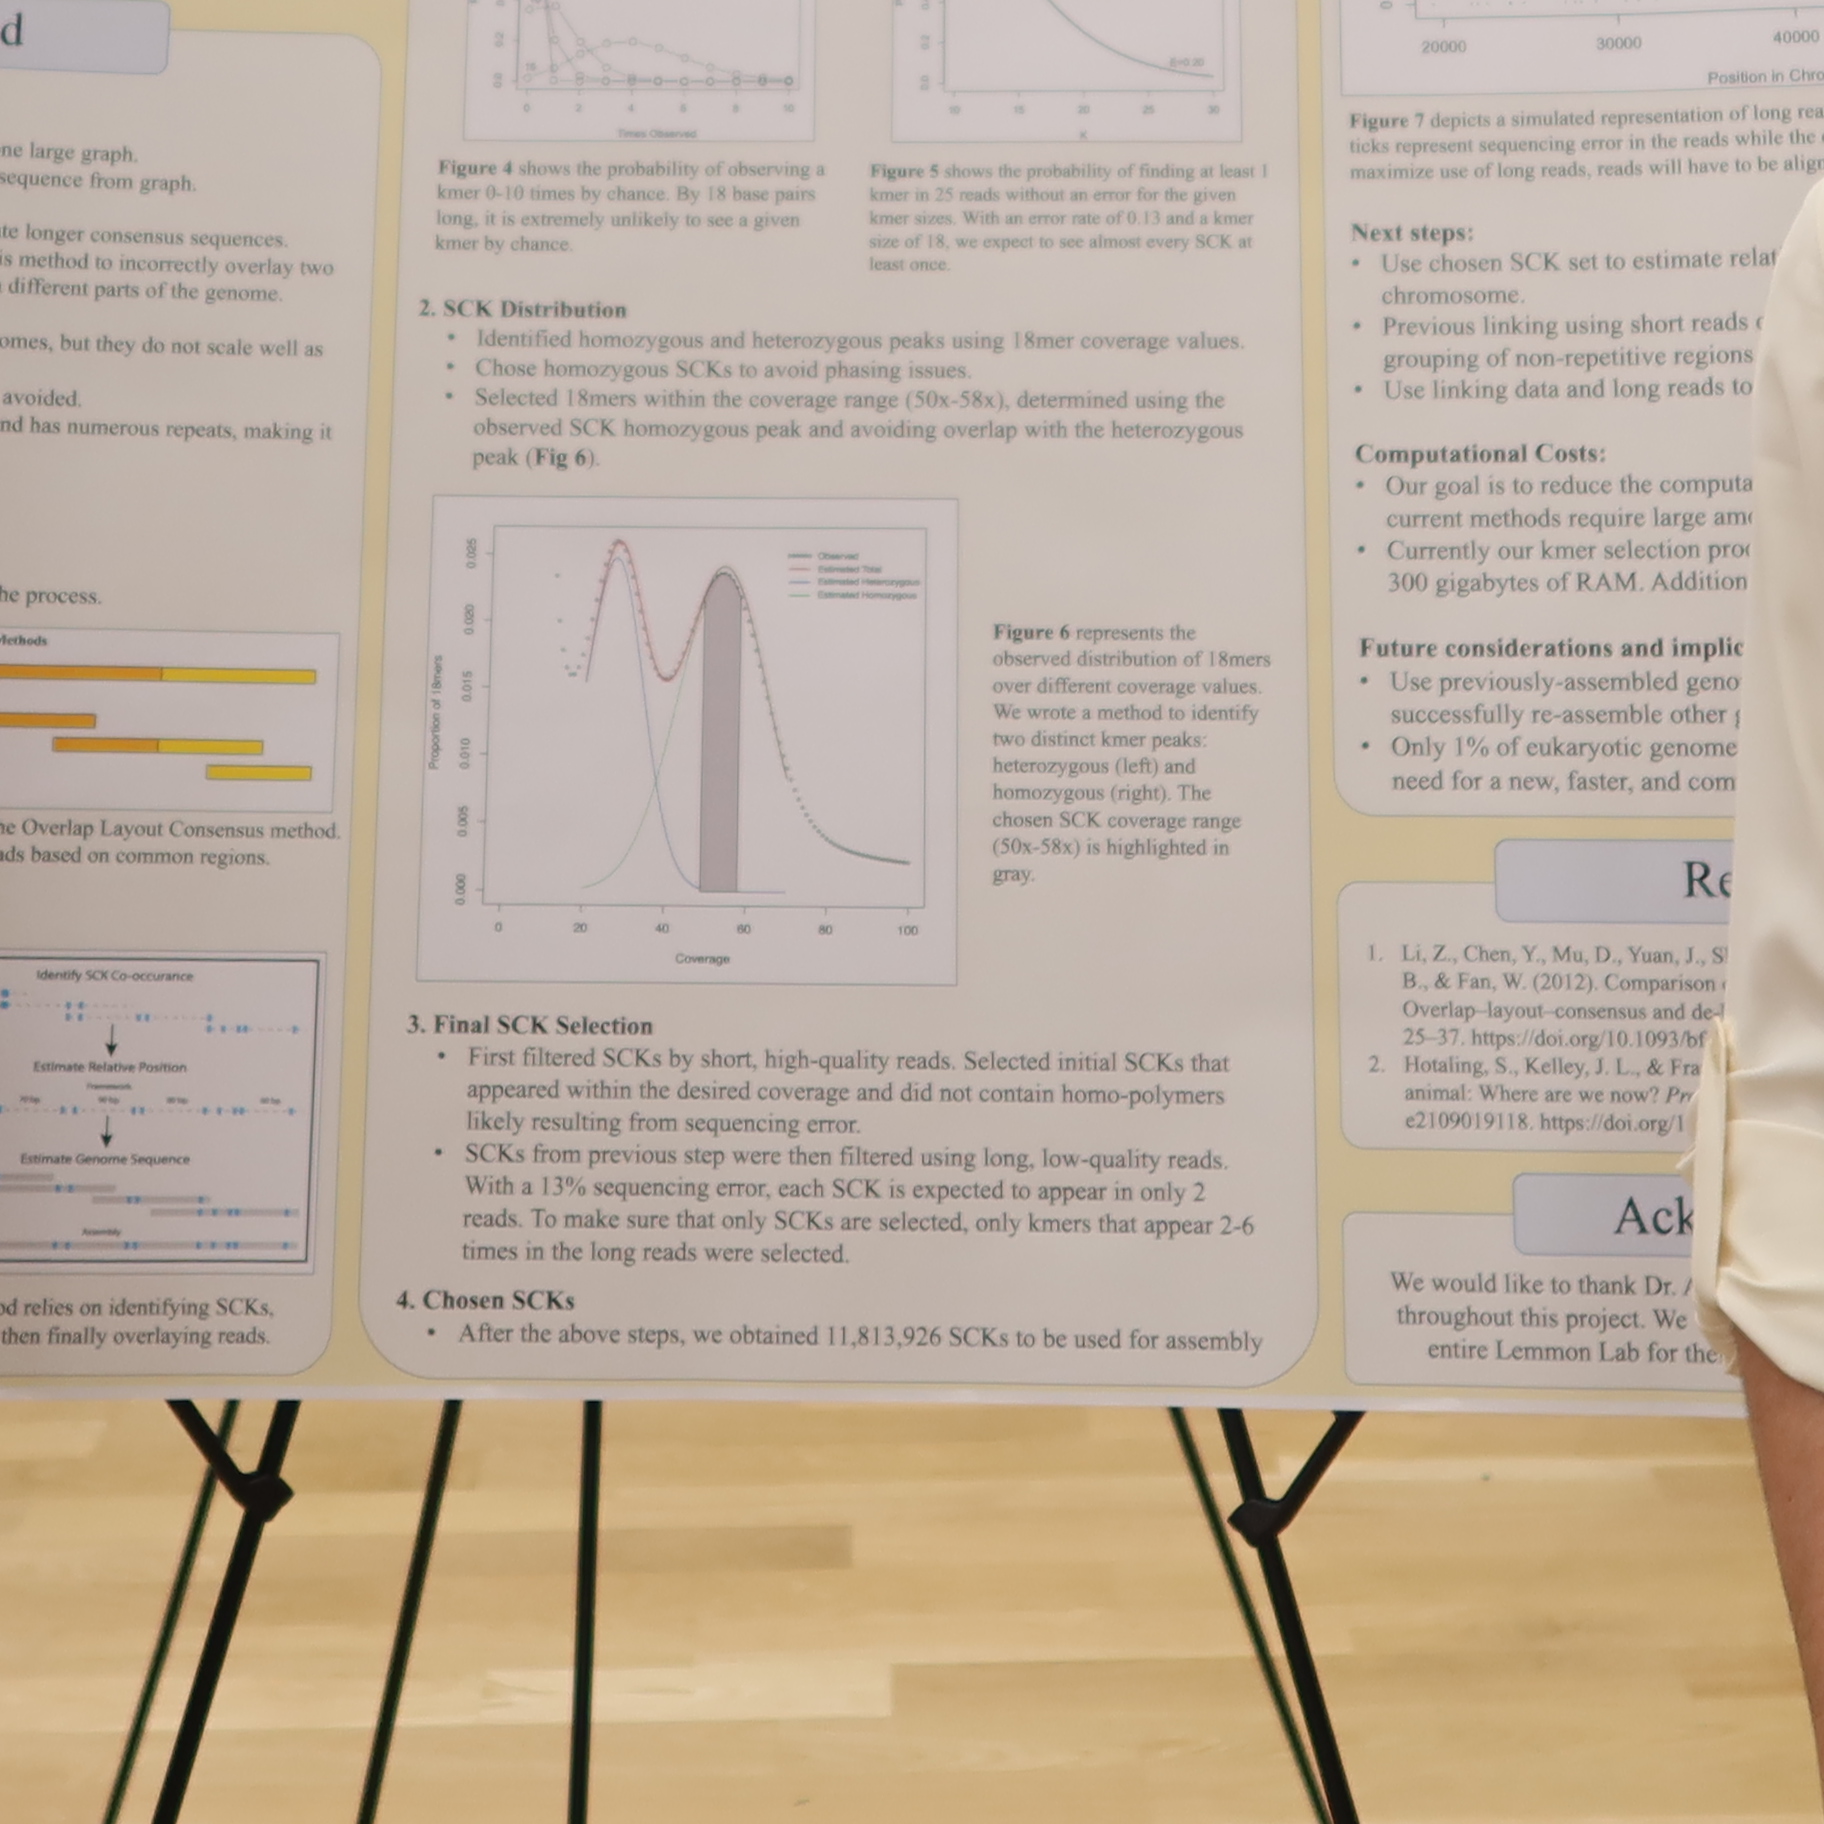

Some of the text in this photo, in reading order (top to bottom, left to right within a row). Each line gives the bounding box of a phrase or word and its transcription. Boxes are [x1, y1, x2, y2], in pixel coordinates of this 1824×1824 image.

[1420, 39, 1467, 55] 20000
[1596, 35, 1642, 51] 30000
[1772, 29, 1820, 46] 40000
[1353, 224, 1473, 248] Next steps:
[420, 298, 627, 318] 2. SCK Distribution
[1384, 377, 1754, 405] Use linking data and long reads to
[1355, 444, 1606, 468] Computational Costs:
[1359, 636, 1743, 662] Future considerations and implic
[1683, 860, 1732, 898] Re
[407, 1015, 654, 1036] 3. Final SCK Selection
[20, 1152, 191, 1168] Estimate Genome Sequence
[1615, 1195, 1694, 1236] Ack
[1391, 1271, 1675, 1297] We would like to thank Dr.
[396, 1289, 575, 1310] 4. Chosen SCKs
[459, 1323, 1263, 1357] After the above steps, we obtained 11,813,926 SCKs to be used for assembly
